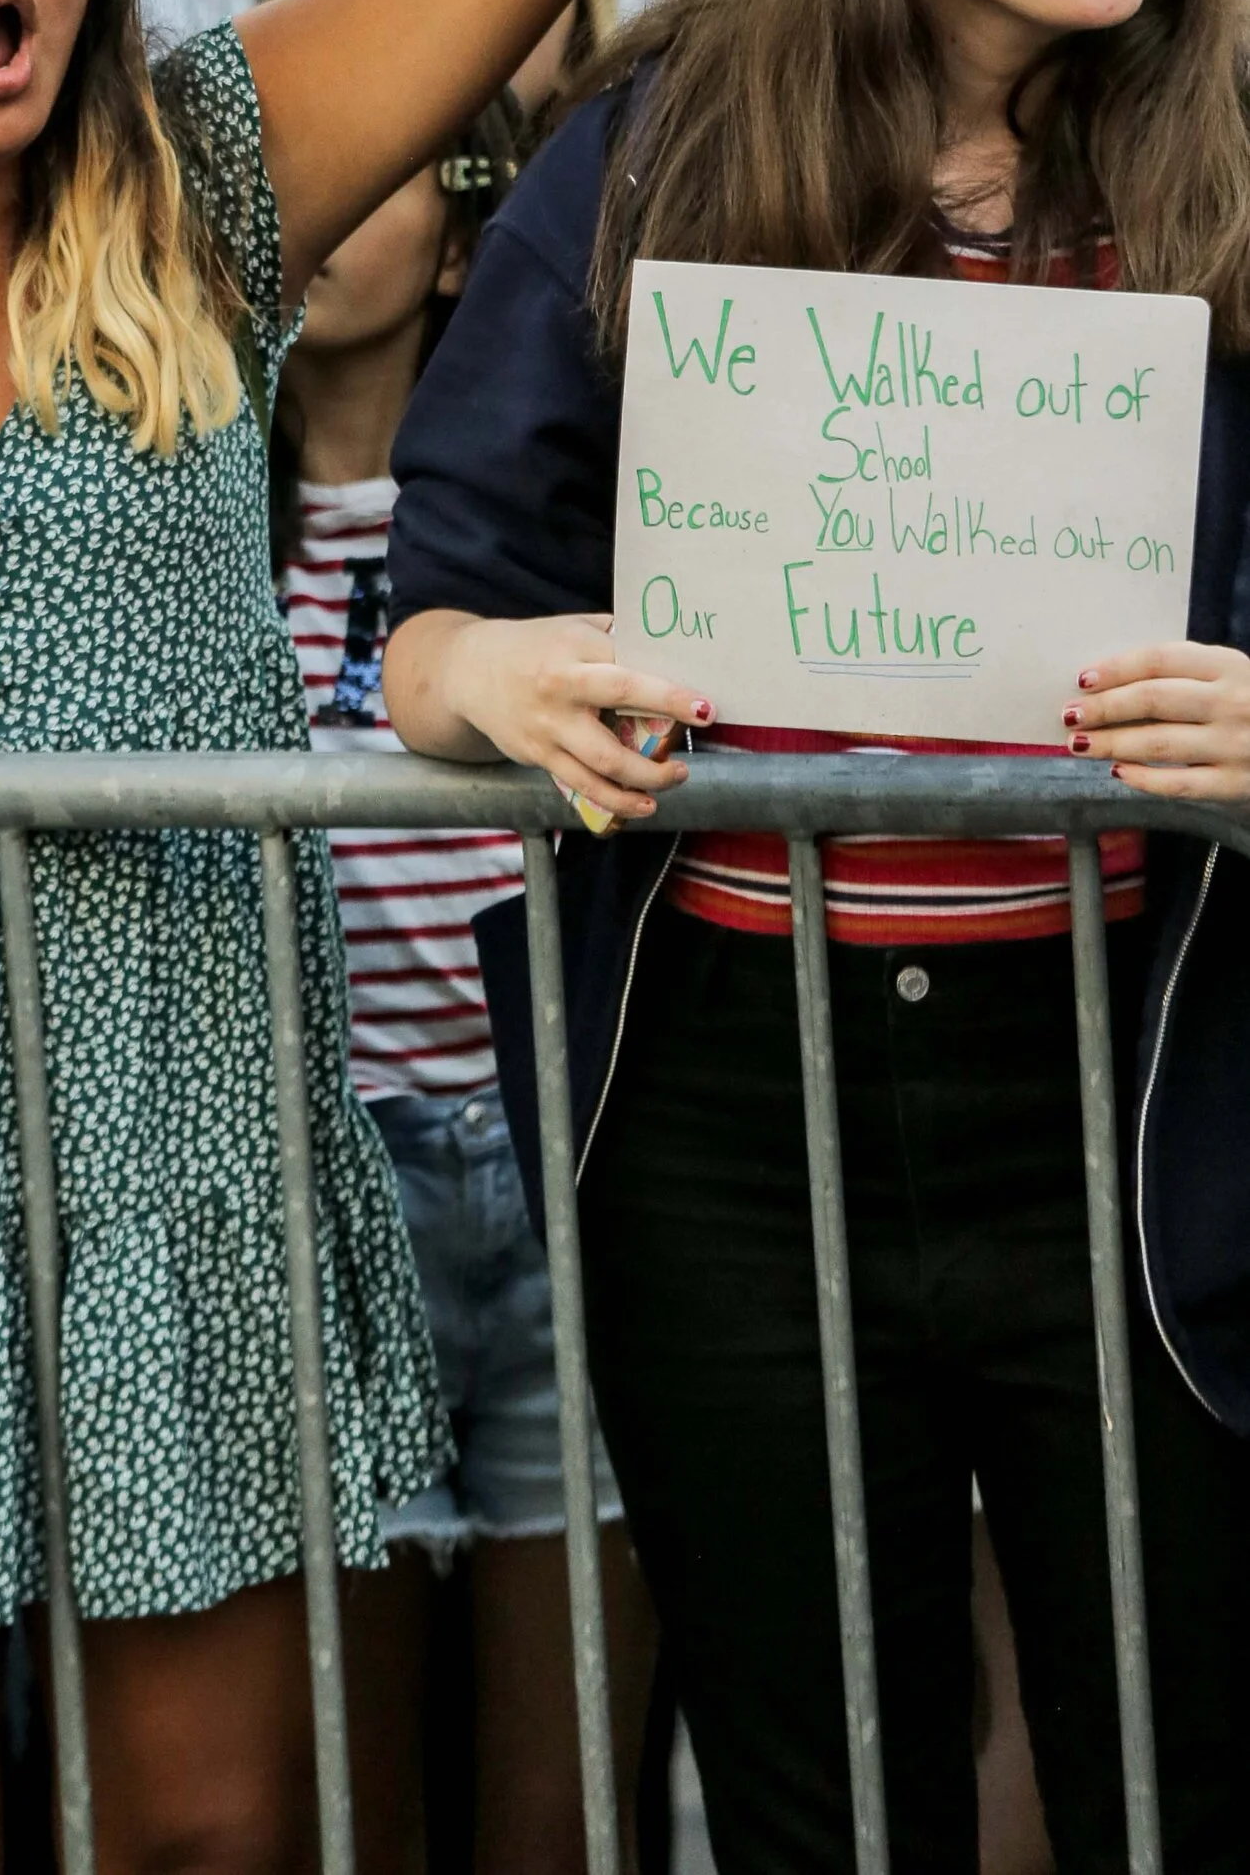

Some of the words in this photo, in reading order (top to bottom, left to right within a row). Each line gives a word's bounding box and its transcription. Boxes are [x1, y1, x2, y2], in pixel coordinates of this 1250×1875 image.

[651, 290, 758, 397] We
[806, 306, 985, 410] Walked
[1015, 352, 1089, 424] out
[817, 405, 933, 484] School
[636, 467, 771, 535] Because
[808, 482, 875, 548] You
[889, 485, 1038, 558] Walked
[1053, 516, 1115, 561] out
[1126, 534, 1175, 575] on
[641, 575, 717, 640] Our
[782, 560, 985, 659] Future
